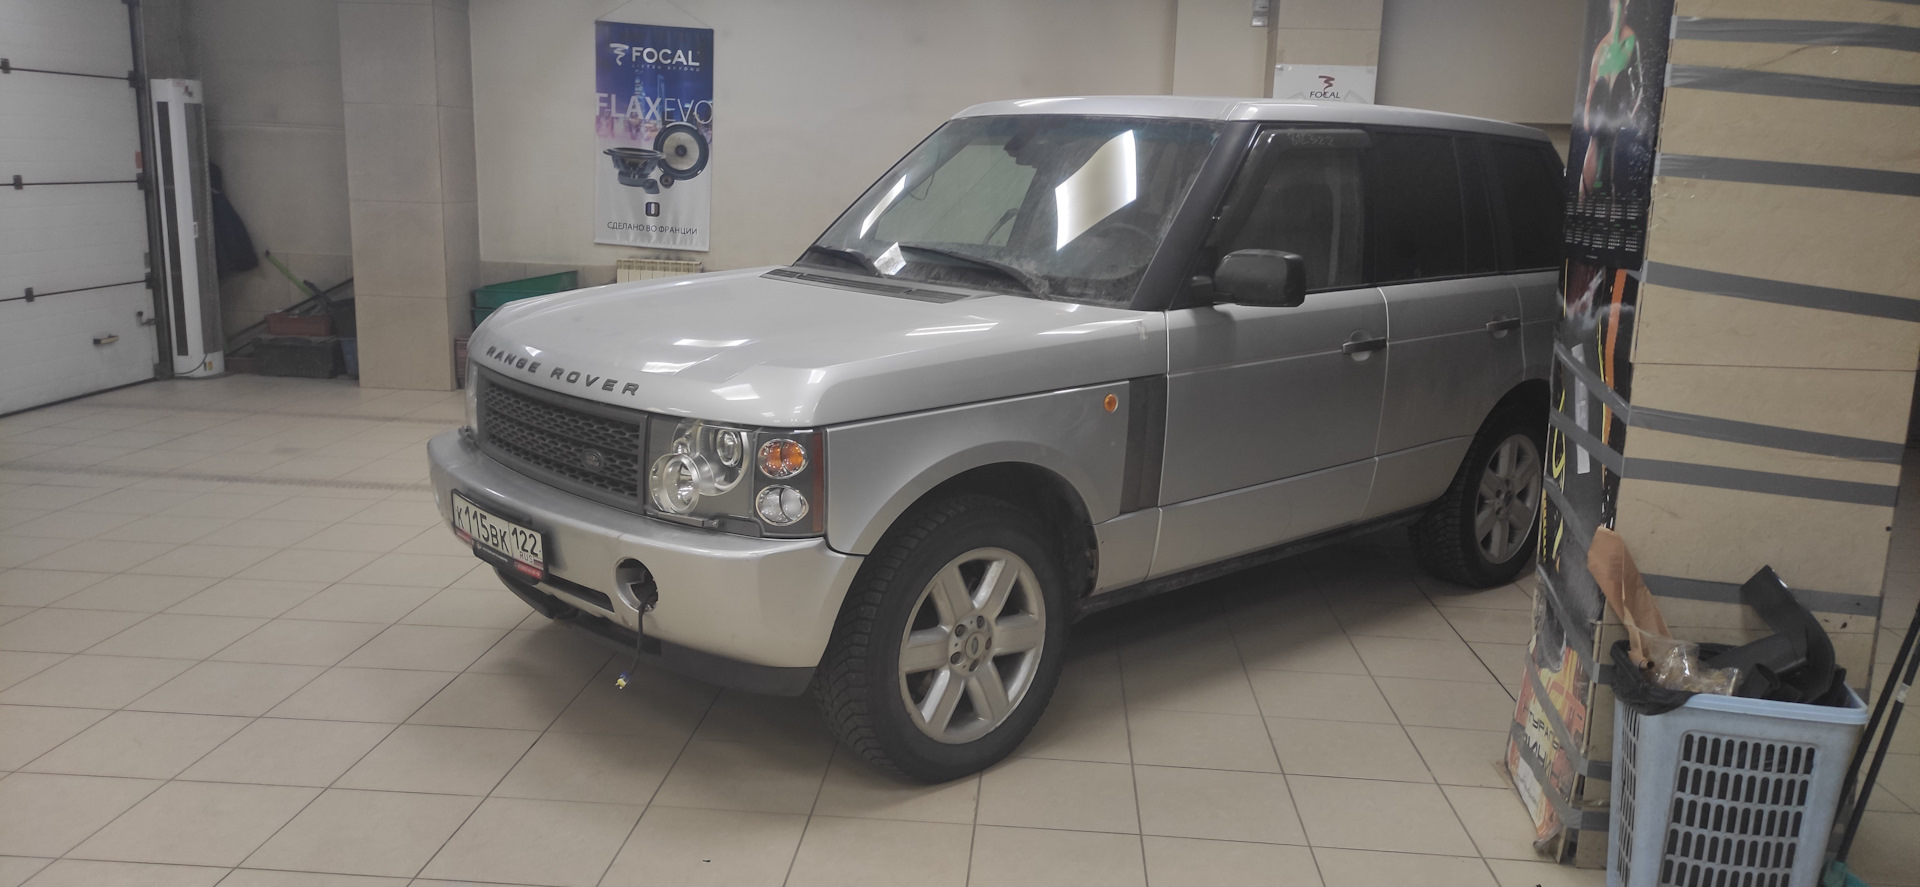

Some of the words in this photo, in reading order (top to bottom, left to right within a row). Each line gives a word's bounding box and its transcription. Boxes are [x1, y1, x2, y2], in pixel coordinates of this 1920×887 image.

[631, 46, 700, 67] FOCAL
[1309, 91, 1341, 99] FOCAL
[607, 221, 644, 232] СДЕЛАНО
[645, 224, 657, 233] ВО
[658, 225, 698, 235] ФРАНЦИИ
[486, 346, 541, 374] RANGE
[550, 366, 640, 396] ROVER
[511, 527, 539, 557] 122
[519, 551, 535, 564] RUS
